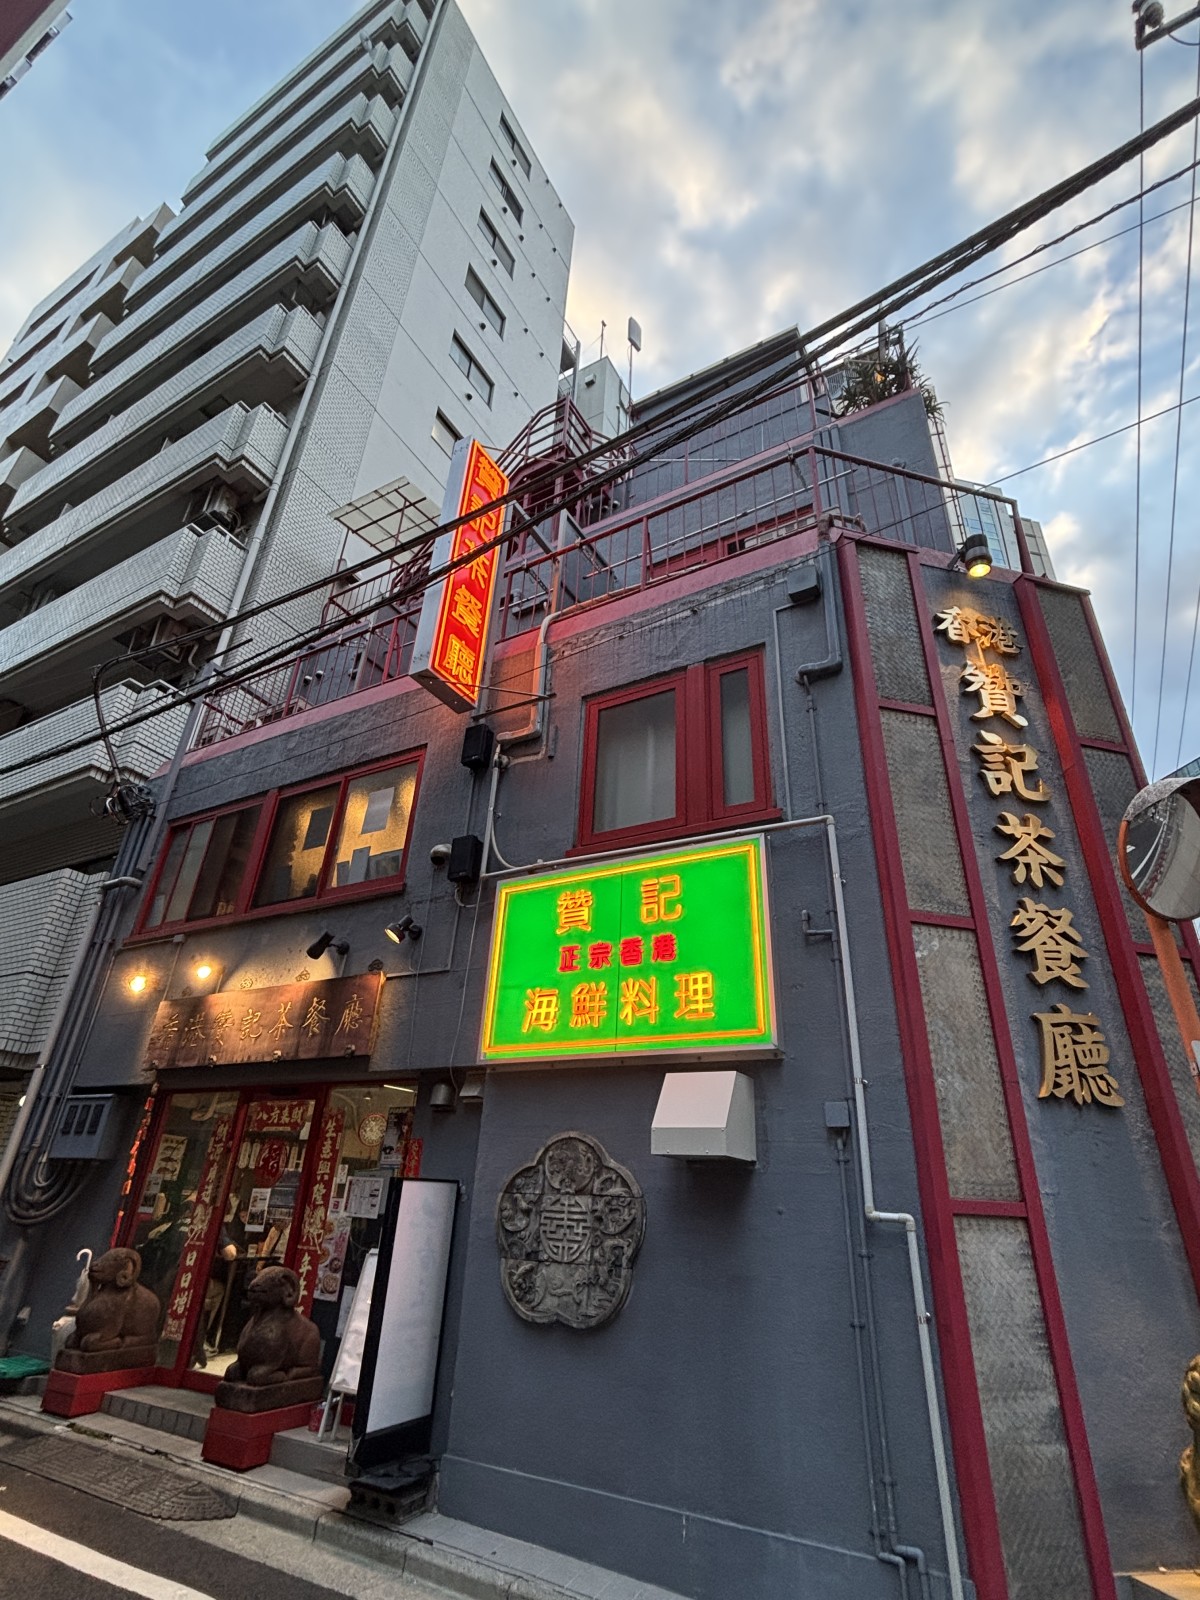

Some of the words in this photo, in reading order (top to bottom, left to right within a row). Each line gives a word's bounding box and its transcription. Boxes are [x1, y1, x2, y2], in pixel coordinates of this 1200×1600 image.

[558, 934, 677, 972] 正宗香港
[521, 971, 715, 1033] 海鮮料理
